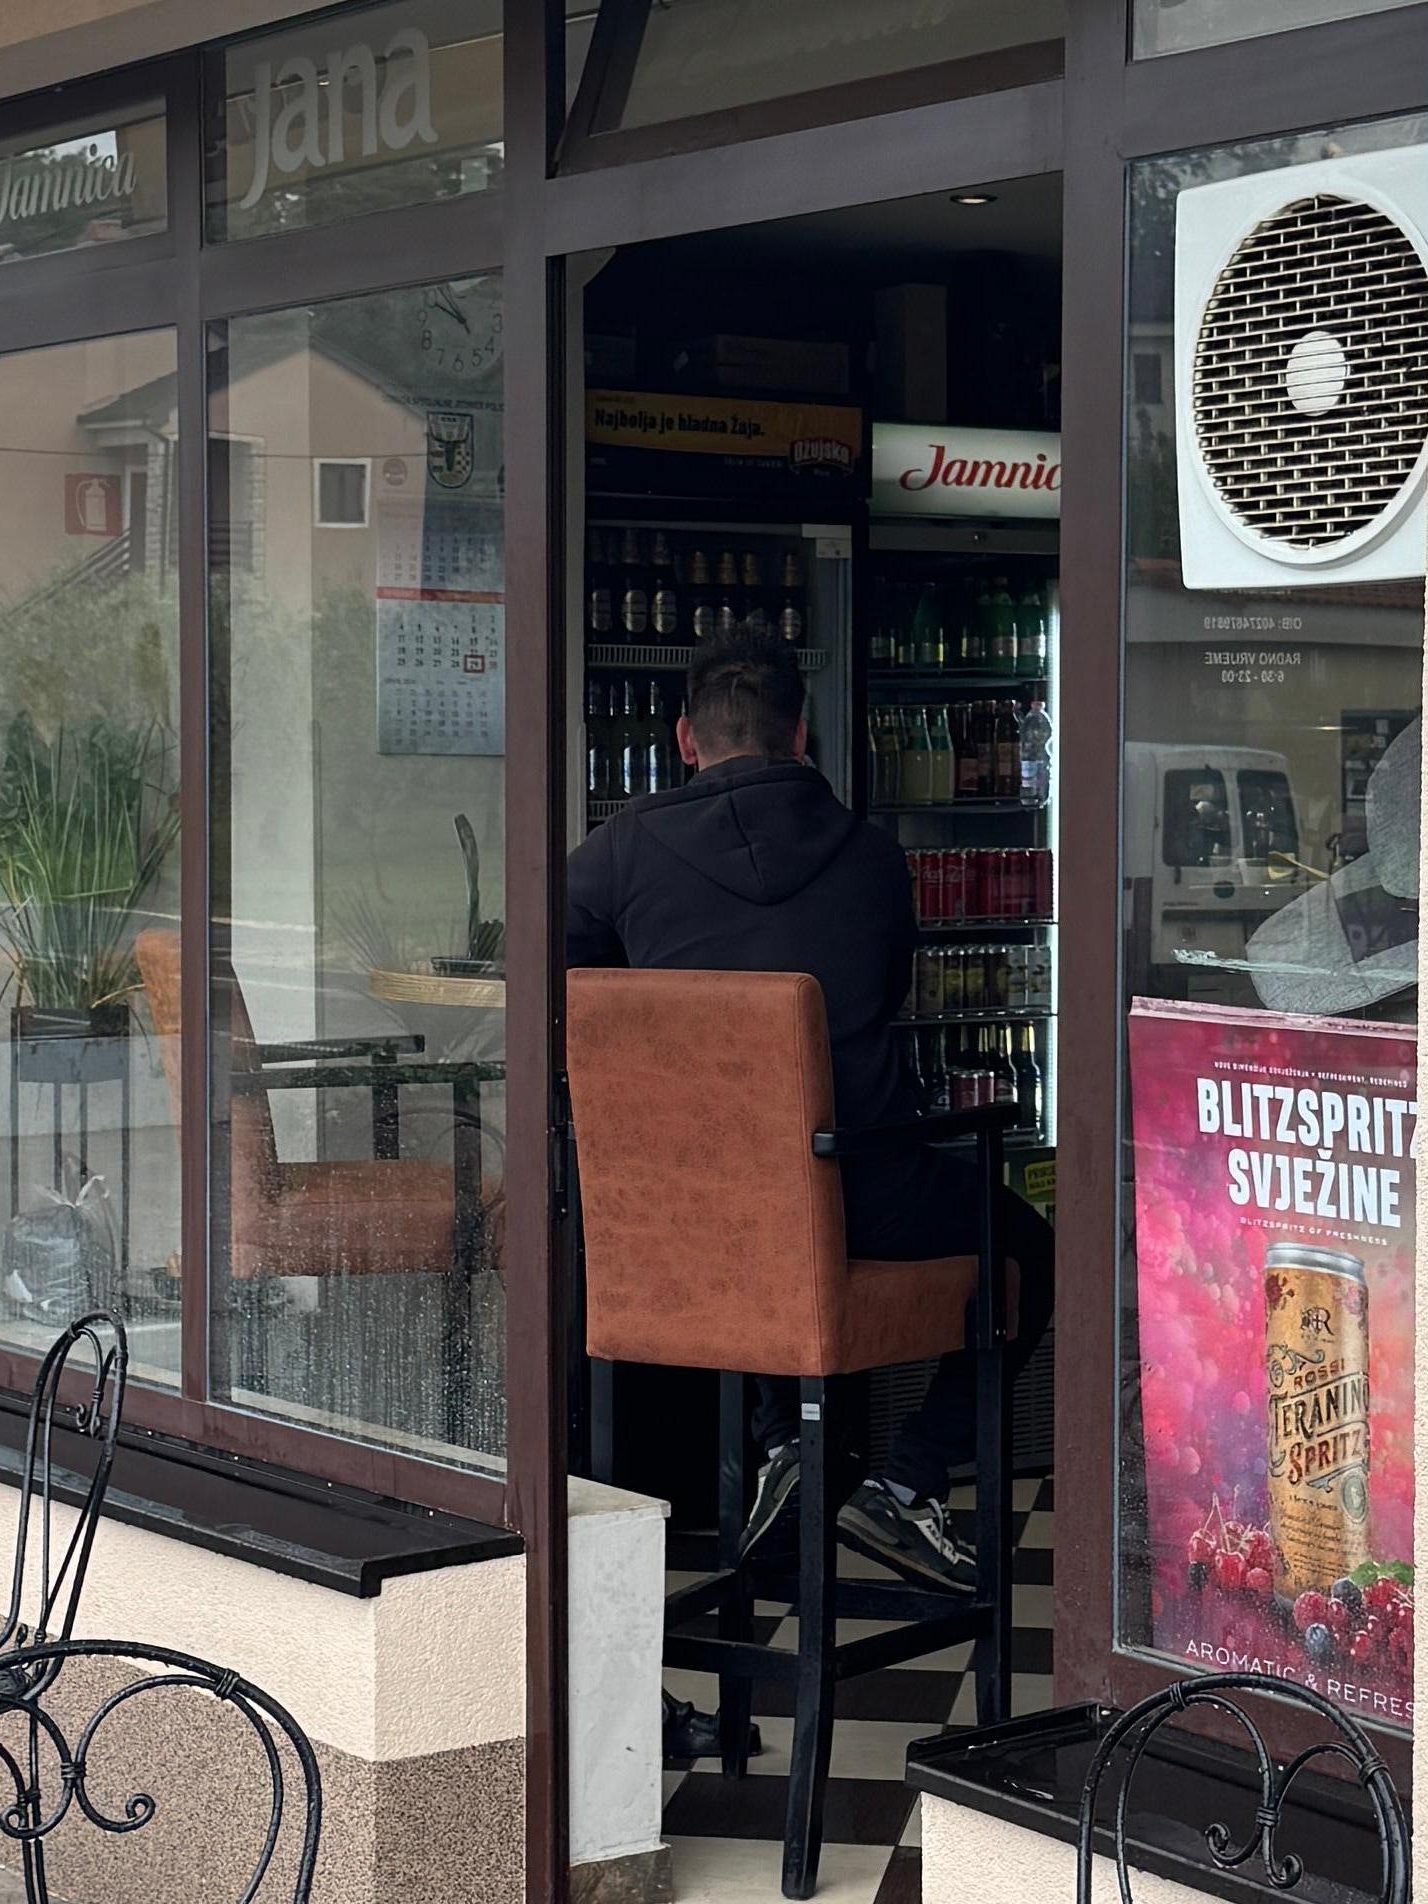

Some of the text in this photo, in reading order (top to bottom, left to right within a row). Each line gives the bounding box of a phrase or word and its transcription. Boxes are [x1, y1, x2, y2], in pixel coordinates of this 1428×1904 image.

[595, 408, 656, 432] Najbolja
[660, 412, 674, 433] je
[1228, 1148, 1400, 1228] SVJEŽINE
[1294, 1360, 1344, 1390] ROSSI
[1288, 1430, 1360, 1485] SPRITZ
[1327, 1679, 1414, 1719] REFRES
